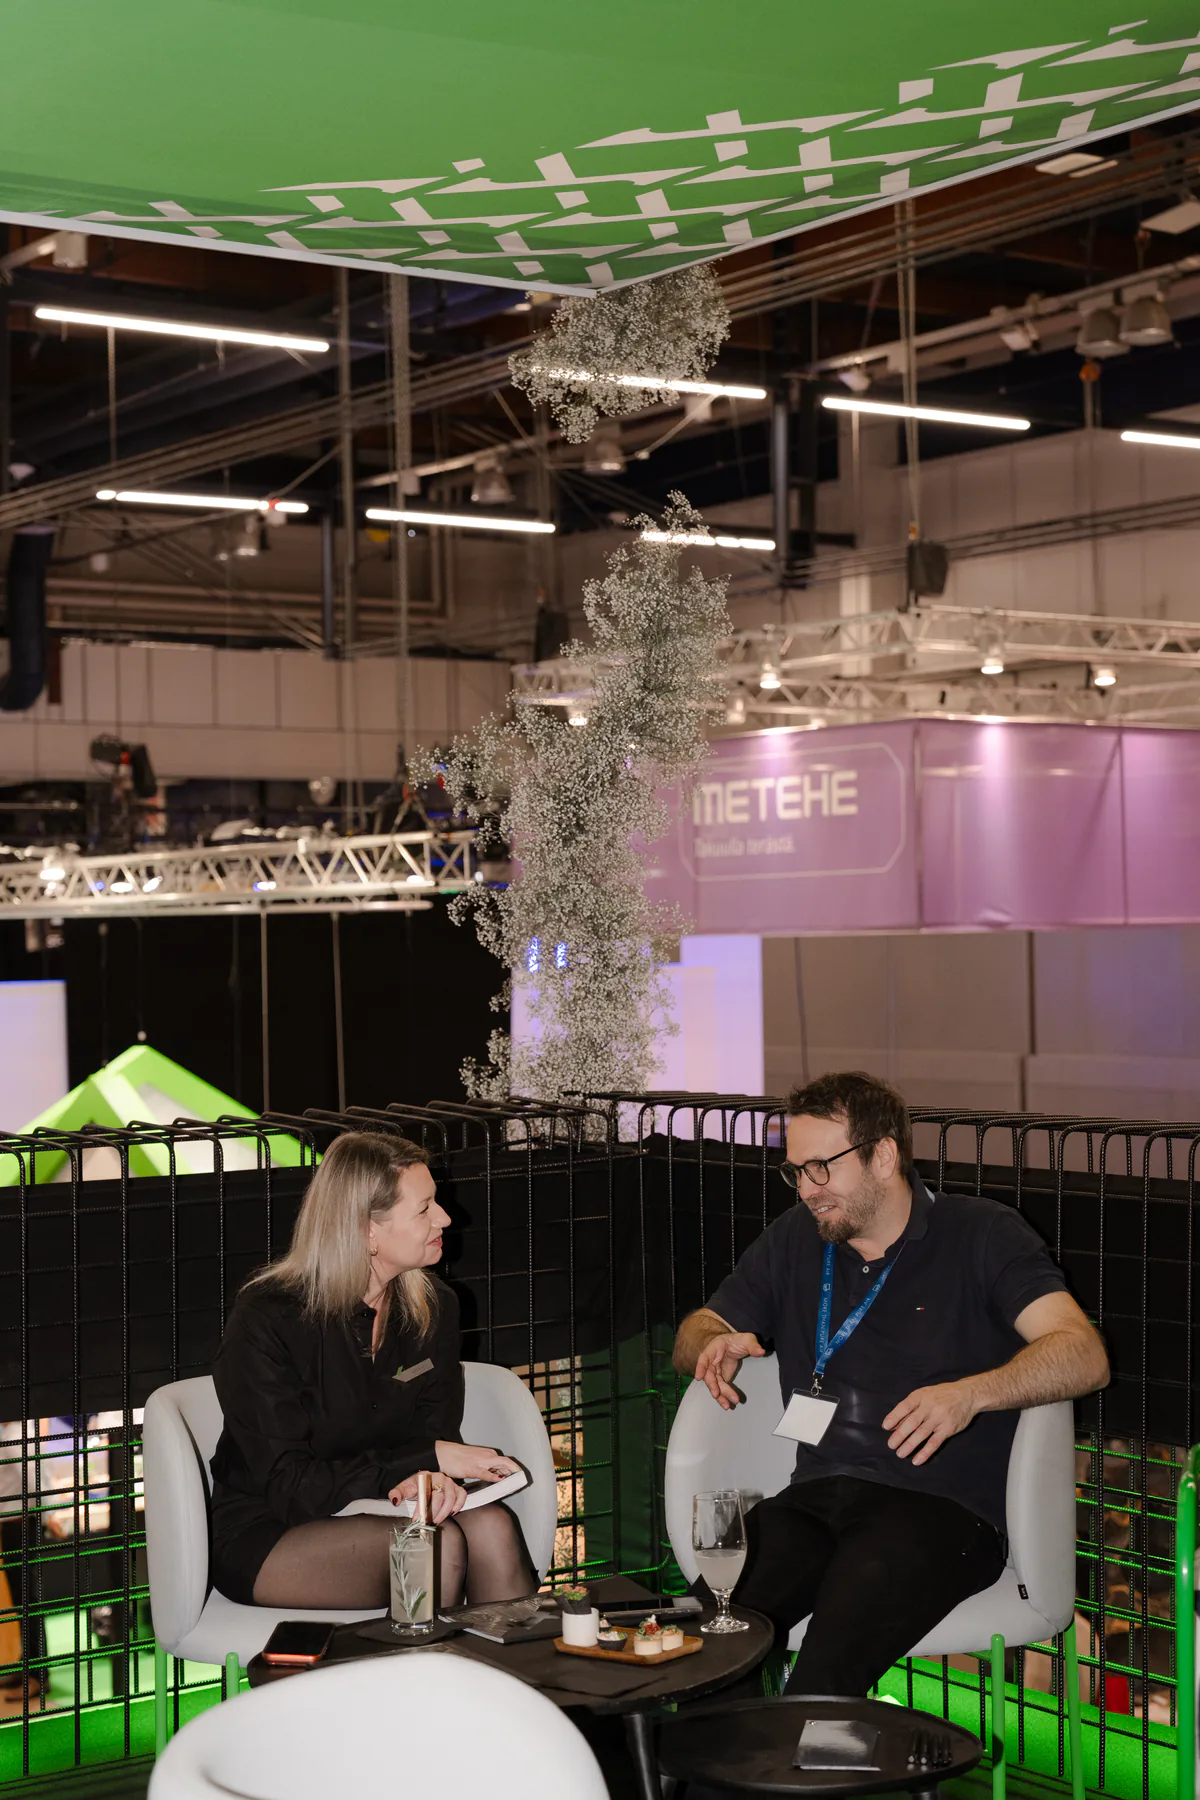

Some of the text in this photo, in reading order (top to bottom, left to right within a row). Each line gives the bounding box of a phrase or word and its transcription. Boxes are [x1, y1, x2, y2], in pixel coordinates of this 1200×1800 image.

[693, 770, 858, 826] METEHE
[835, 1330, 848, 1345] MORE
[855, 1305, 865, 1317] PURE
